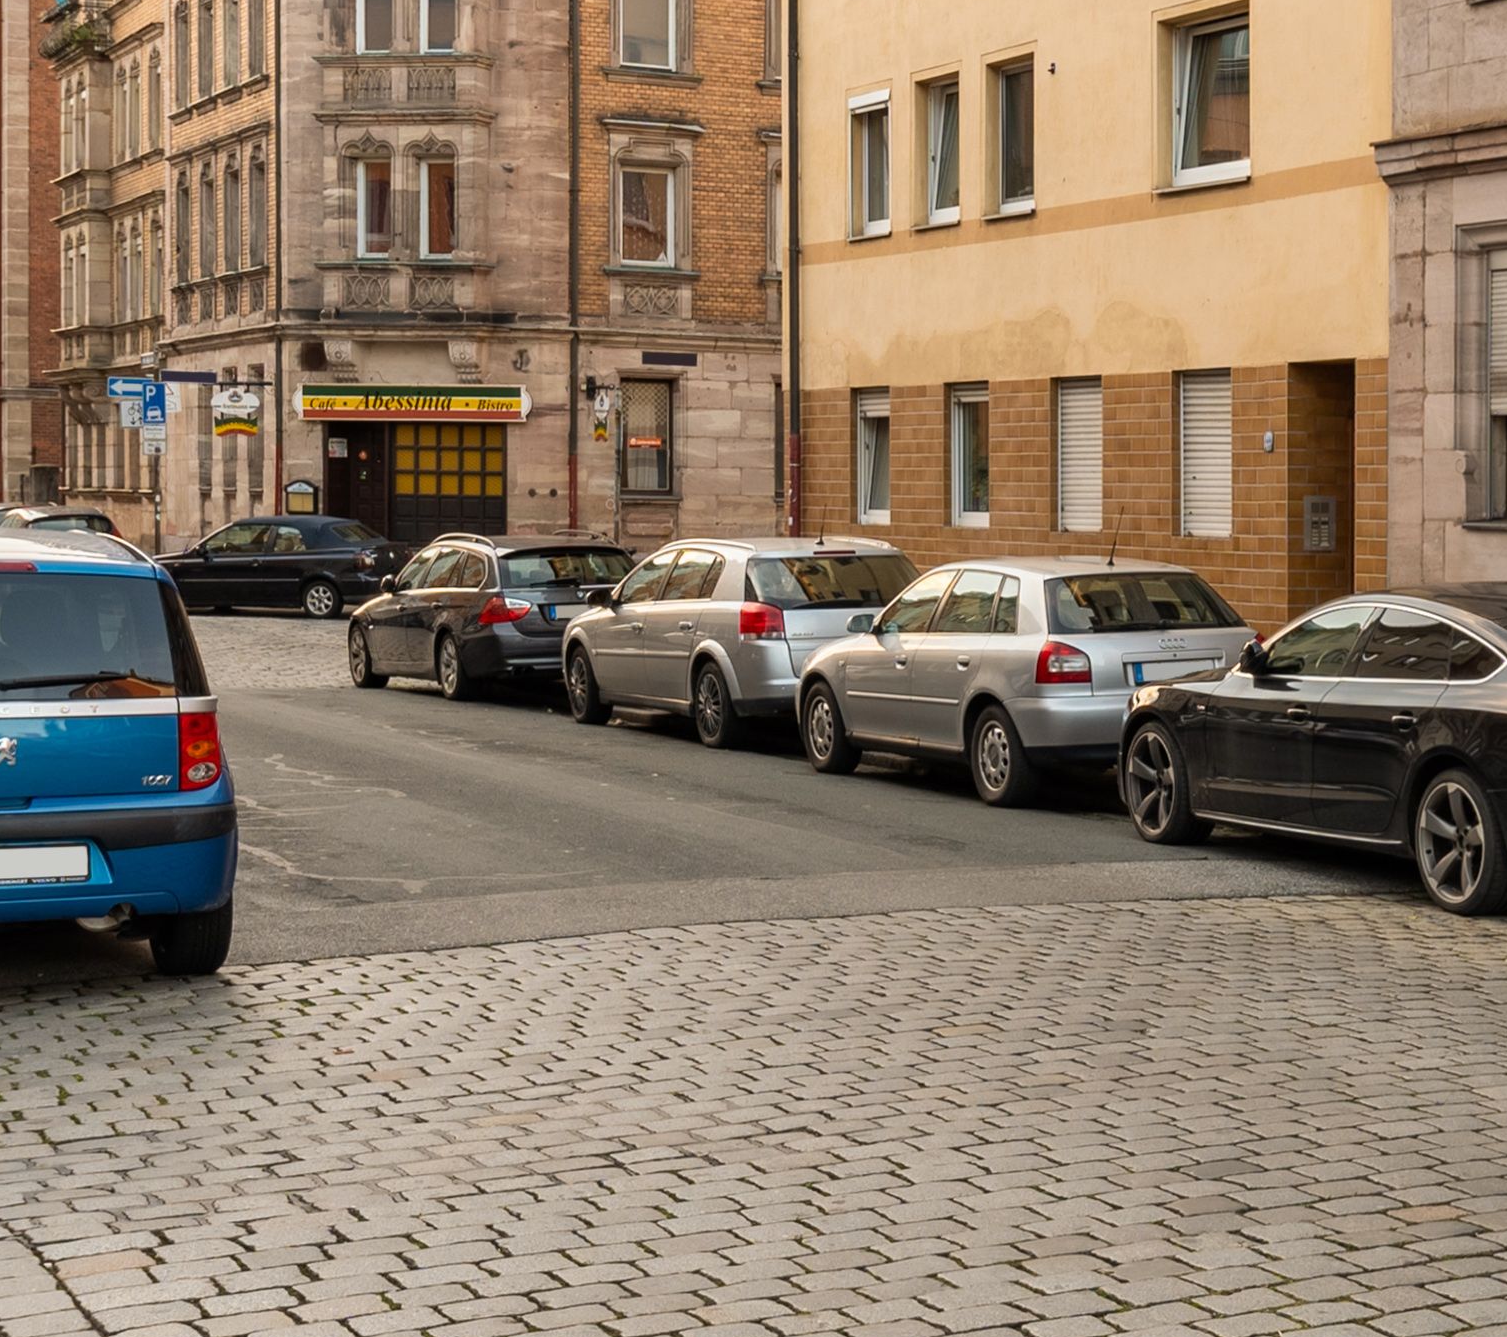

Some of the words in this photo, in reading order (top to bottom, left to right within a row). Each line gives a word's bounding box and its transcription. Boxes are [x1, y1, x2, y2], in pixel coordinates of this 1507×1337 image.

[145, 385, 157, 402] P
[309, 398, 337, 411] Café
[355, 391, 453, 411] Abessinia
[476, 399, 514, 411] Bistro
[141, 774, 173, 786] 1007
